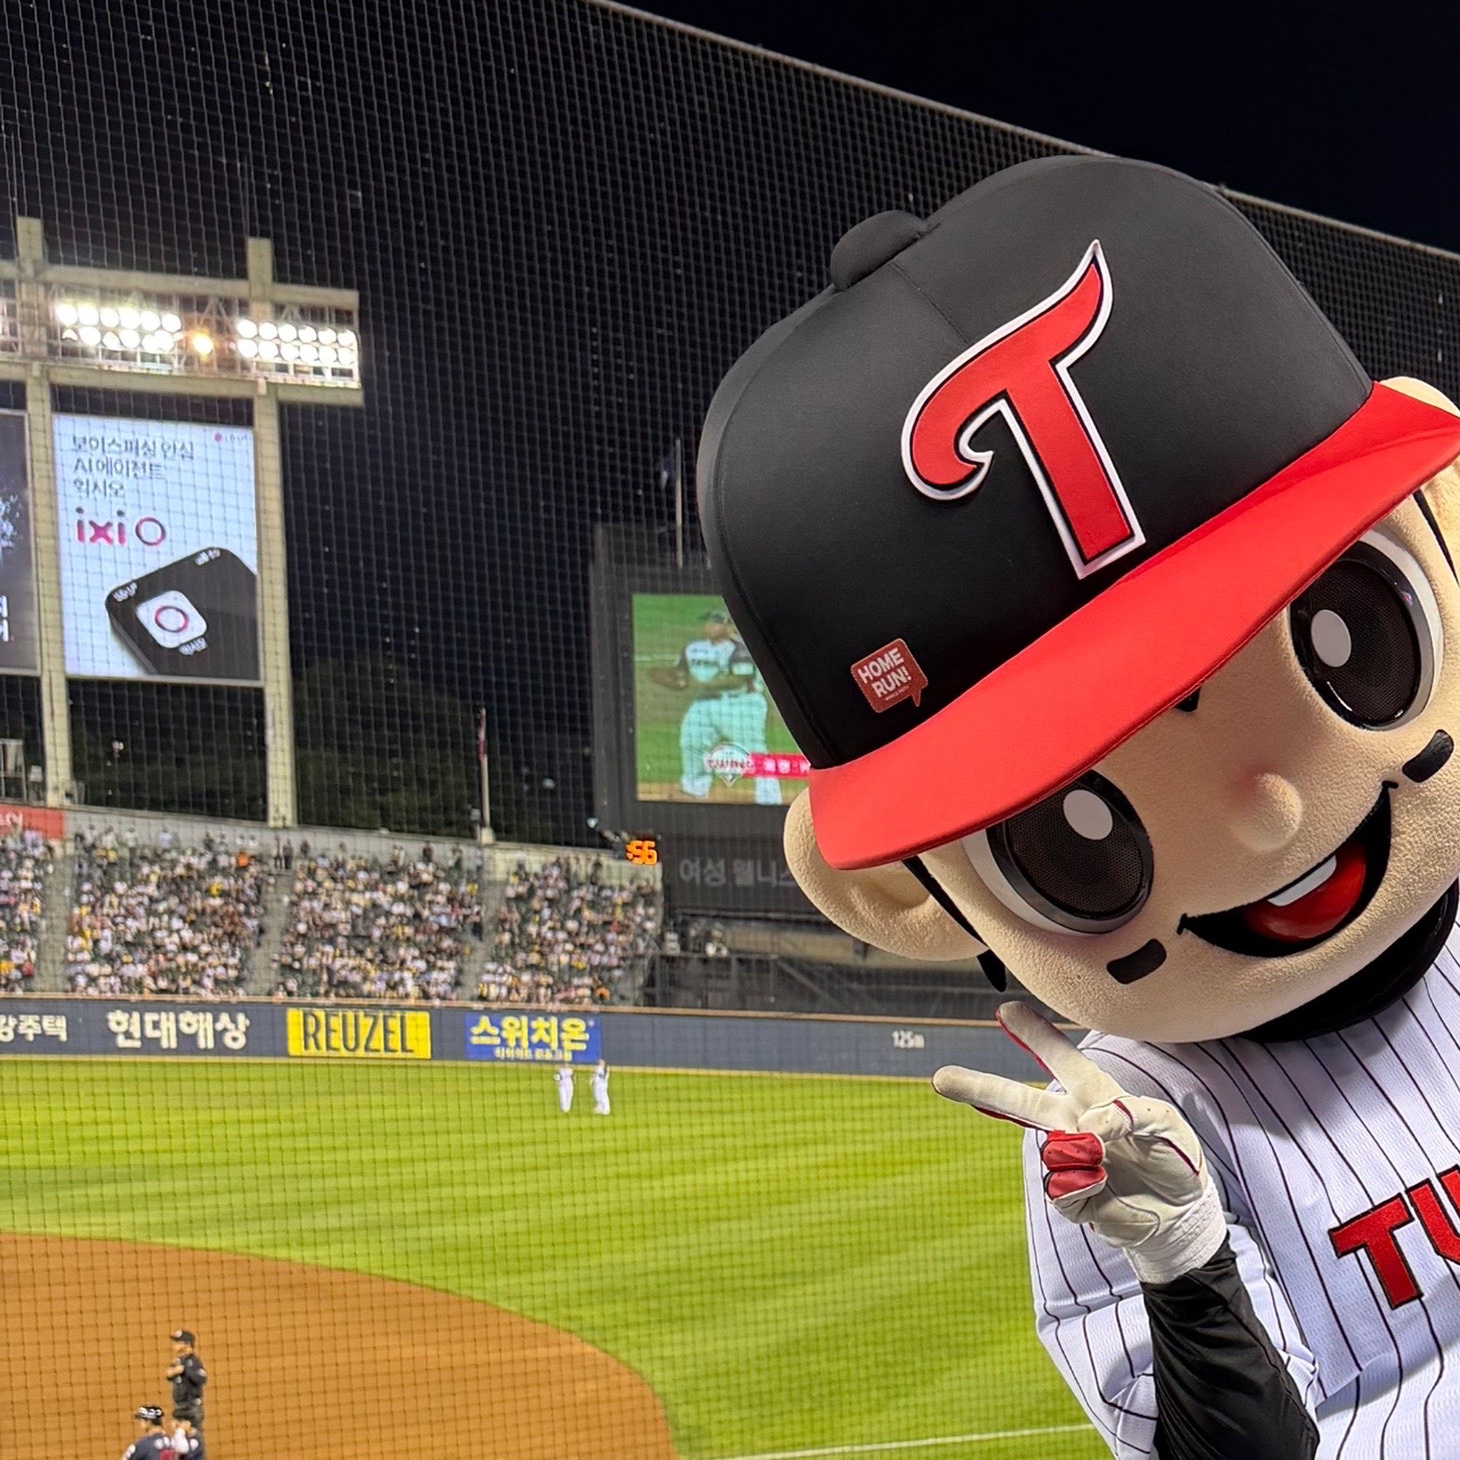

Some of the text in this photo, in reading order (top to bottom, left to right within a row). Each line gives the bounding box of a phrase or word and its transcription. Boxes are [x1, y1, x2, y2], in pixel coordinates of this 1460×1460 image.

[901, 239, 1146, 580] T
[73, 478, 127, 498] 익시오
[857, 647, 904, 684] HOME
[871, 666, 912, 698] RUN!
[106, 1009, 250, 1050] 현대해상
[302, 1009, 416, 1054] REUZEL
[470, 1014, 591, 1051] 스위치온
